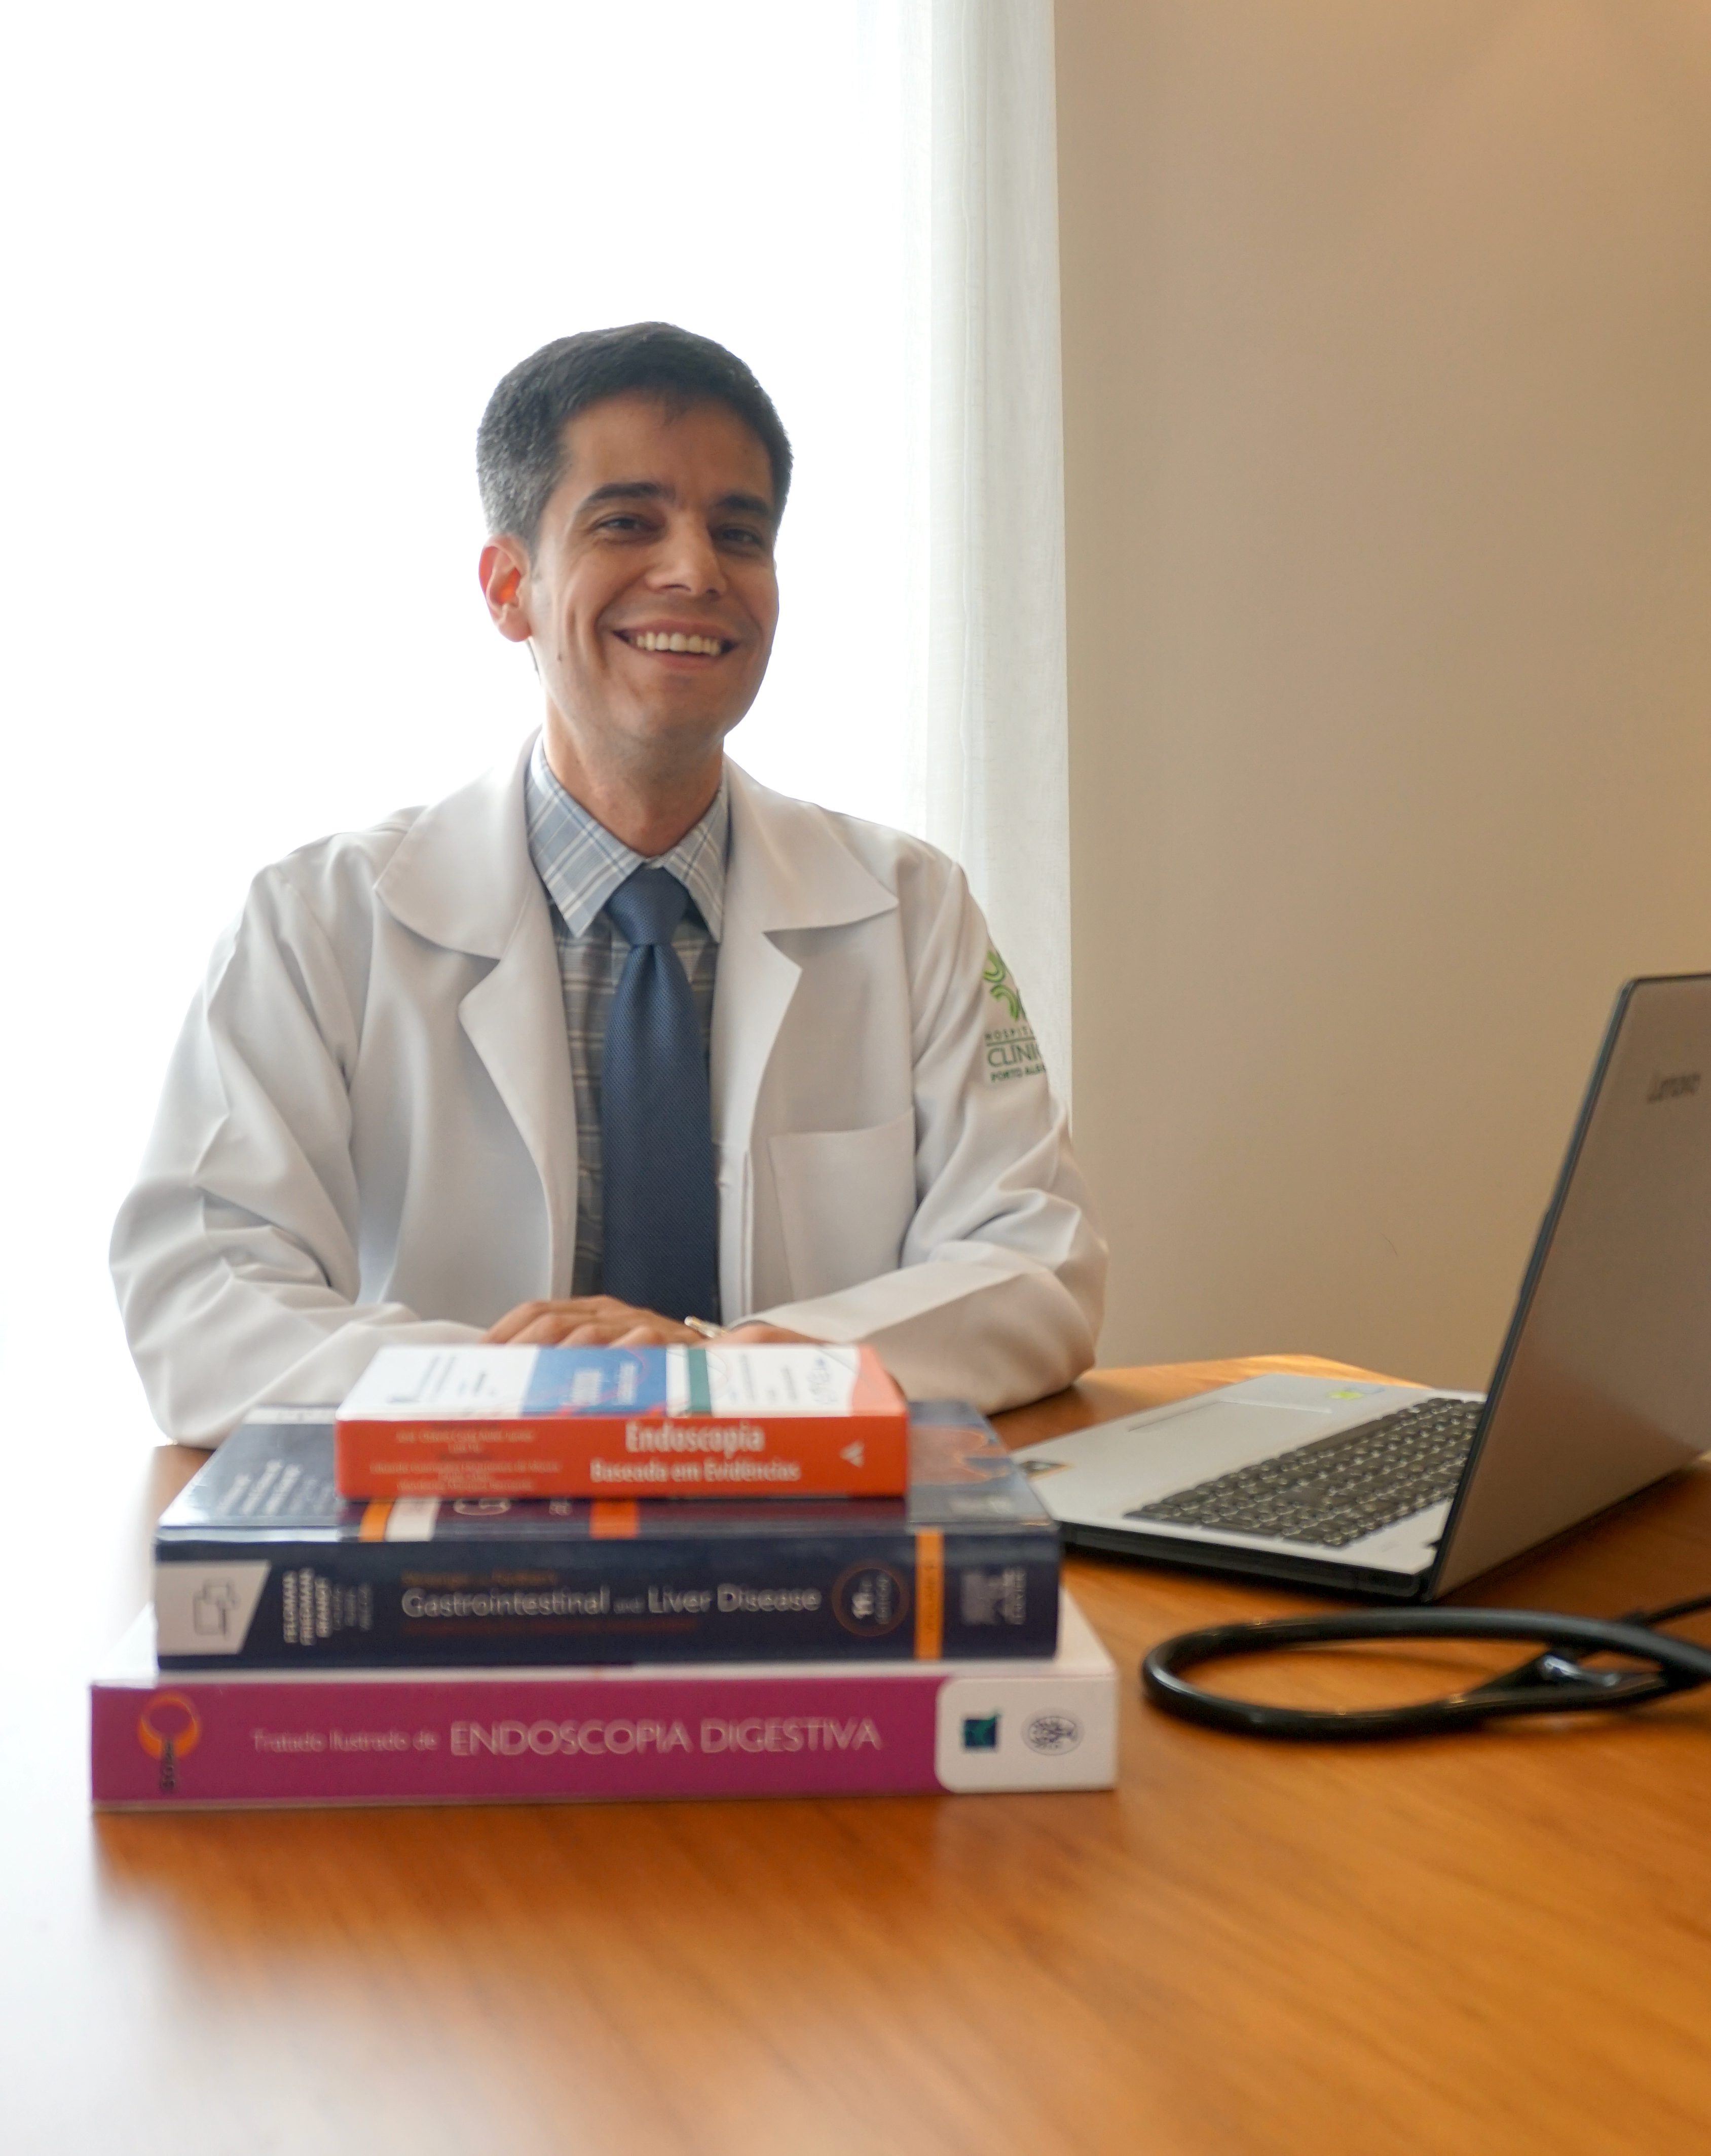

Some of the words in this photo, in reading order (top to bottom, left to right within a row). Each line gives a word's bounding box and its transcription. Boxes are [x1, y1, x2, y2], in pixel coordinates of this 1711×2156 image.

[984, 1026, 1032, 1040] HOSPIT
[987, 1042, 1042, 1067] CLINI
[990, 1067, 1023, 1083] PORTO
[625, 1419, 765, 1459] Endoscopia
[589, 1457, 668, 1483] Baseada
[670, 1461, 702, 1482] em
[703, 1456, 802, 1482] Evidências
[401, 1585, 610, 1618] Gastrointestinal
[647, 1585, 712, 1614] Liver
[716, 1583, 823, 1613] Disease
[250, 1728, 328, 1752] Tratado
[329, 1727, 411, 1751] Ilustrado
[413, 1727, 440, 1751] de
[450, 1719, 693, 1757] ENDOSCOPIA
[700, 1715, 883, 1755] DIGESTIVA
